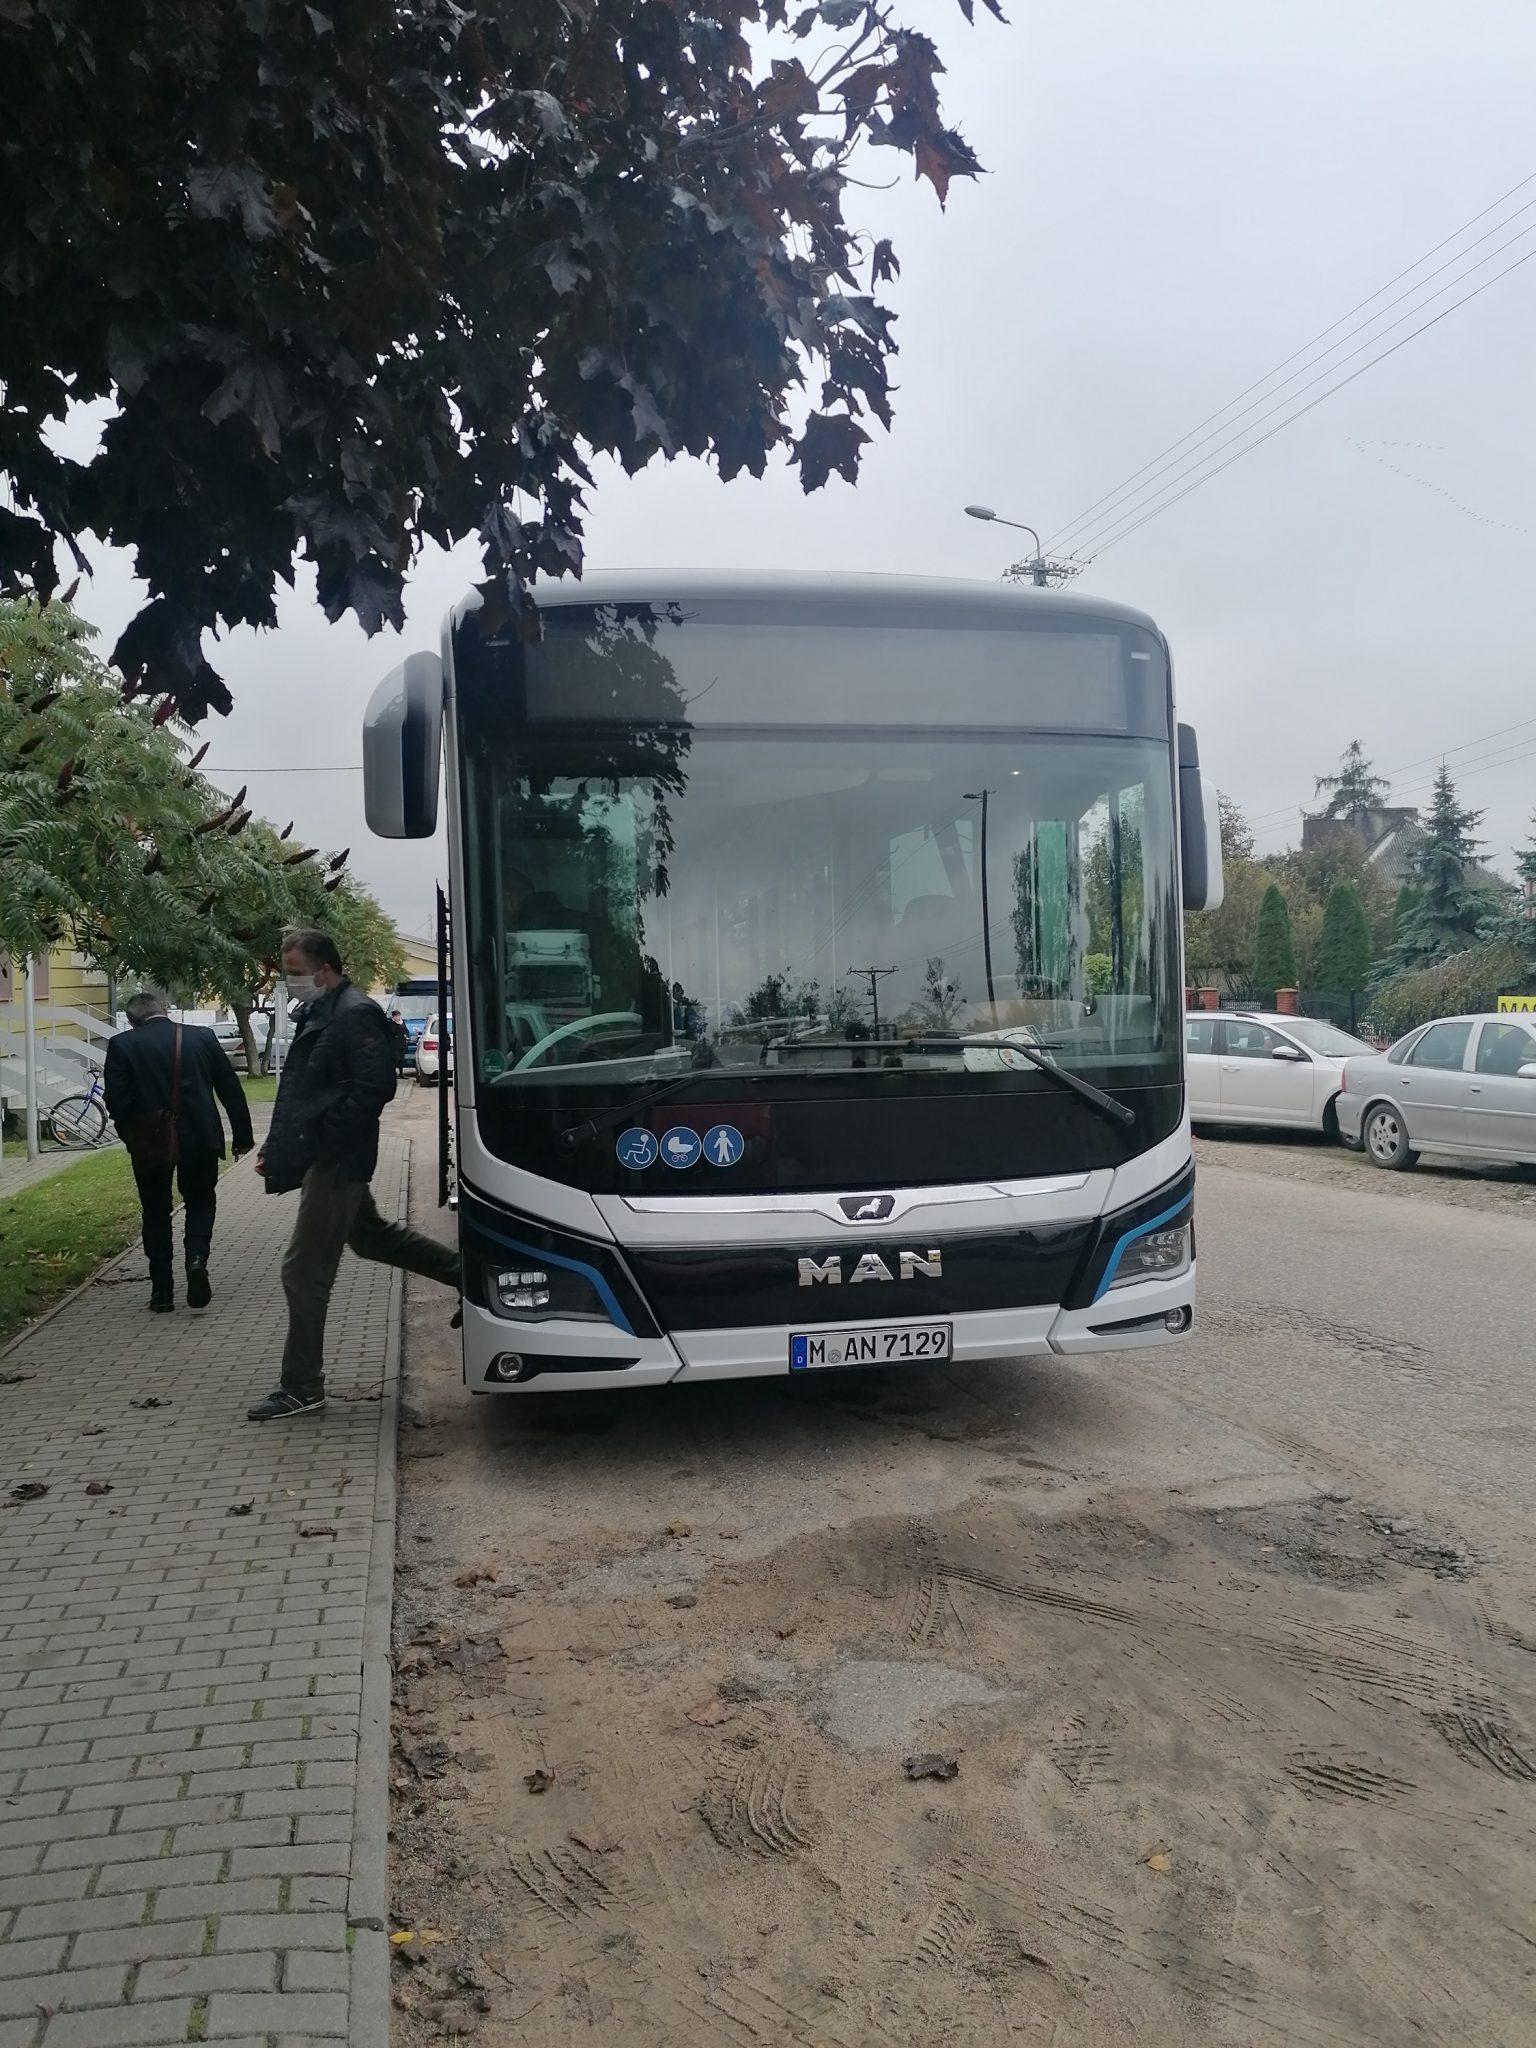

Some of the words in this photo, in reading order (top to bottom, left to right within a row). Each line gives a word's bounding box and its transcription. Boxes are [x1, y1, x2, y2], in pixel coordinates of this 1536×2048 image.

[798, 1250, 942, 1286] MAN
[797, 1356, 803, 1364] D
[809, 1339, 825, 1364] M
[844, 1335, 876, 1361] AN
[883, 1331, 946, 1358] 7129
